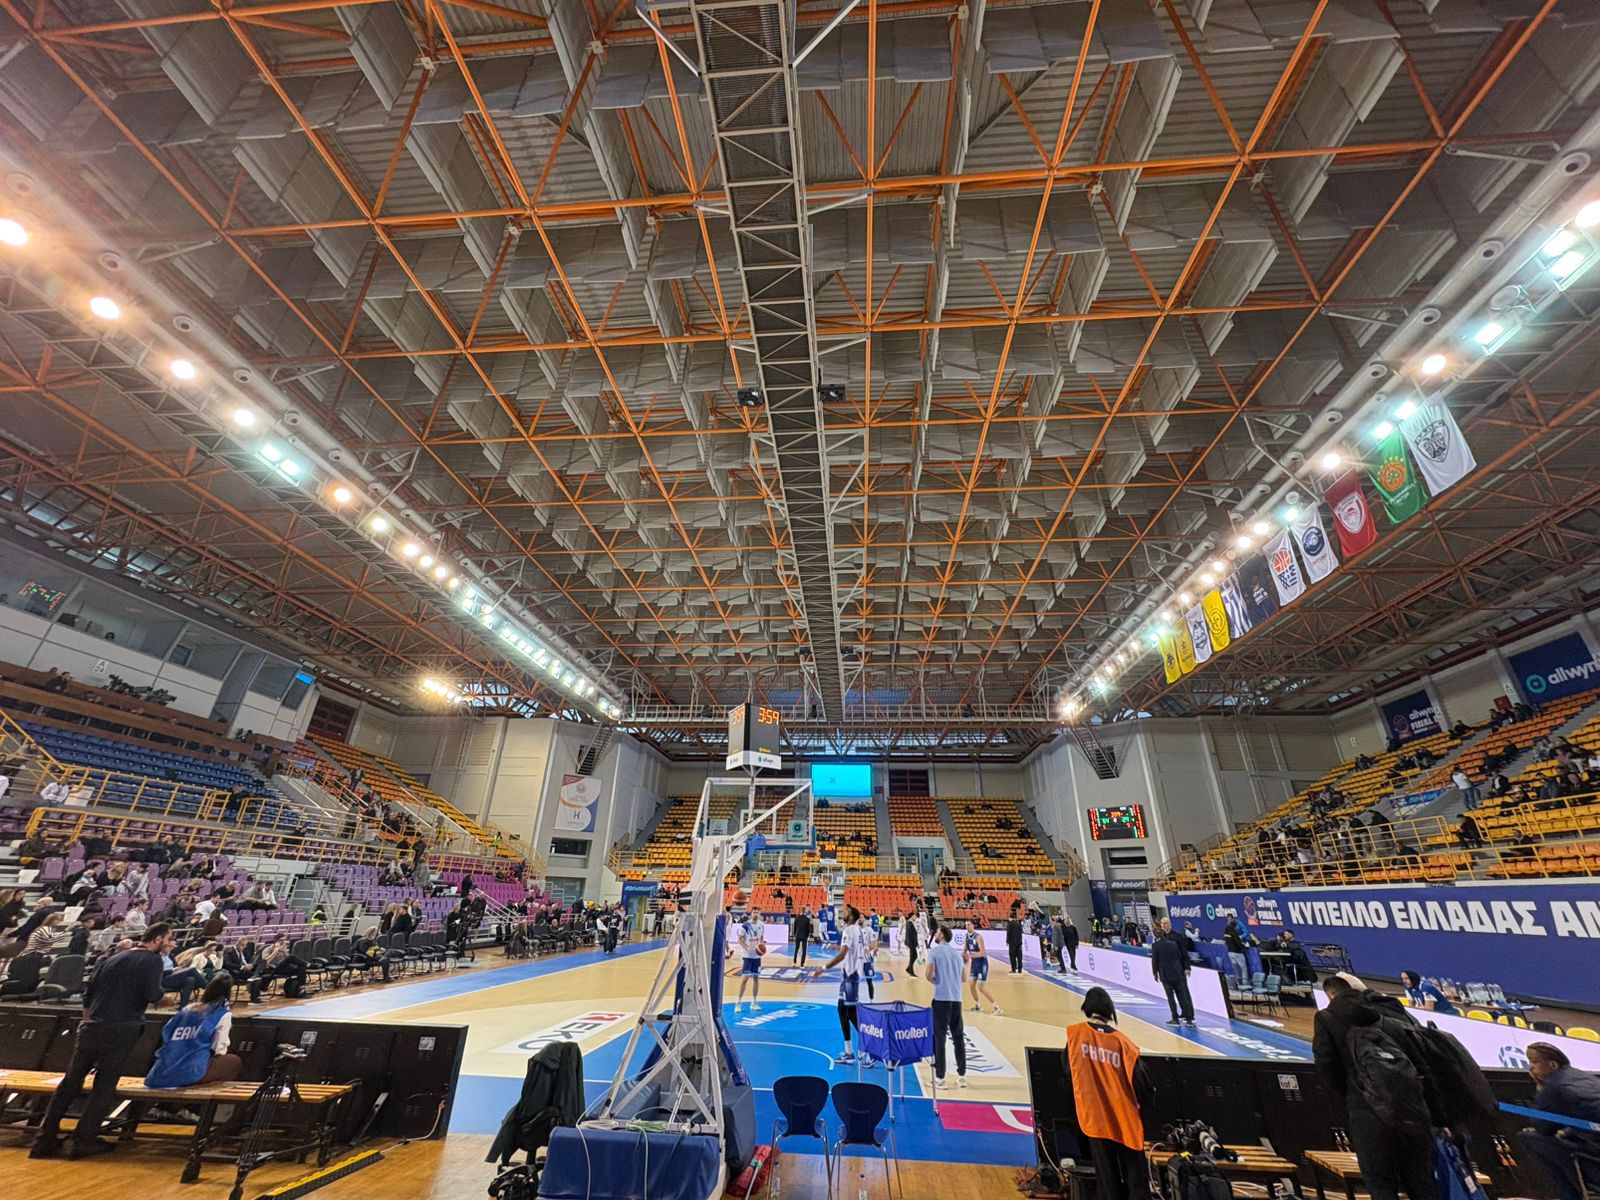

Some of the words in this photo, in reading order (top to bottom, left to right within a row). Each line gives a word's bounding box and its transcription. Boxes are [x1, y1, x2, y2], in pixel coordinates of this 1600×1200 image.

[758, 707, 780, 725] 3:59
[1257, 910, 1277, 920] FINAL
[1288, 901, 1389, 929] ΚΥΠΕΛΛΟ
[1389, 901, 1548, 936] ΕΛΛΑΔΑΣ
[895, 1027, 928, 1040] molten
[1081, 1043, 1121, 1068] PHOTO
